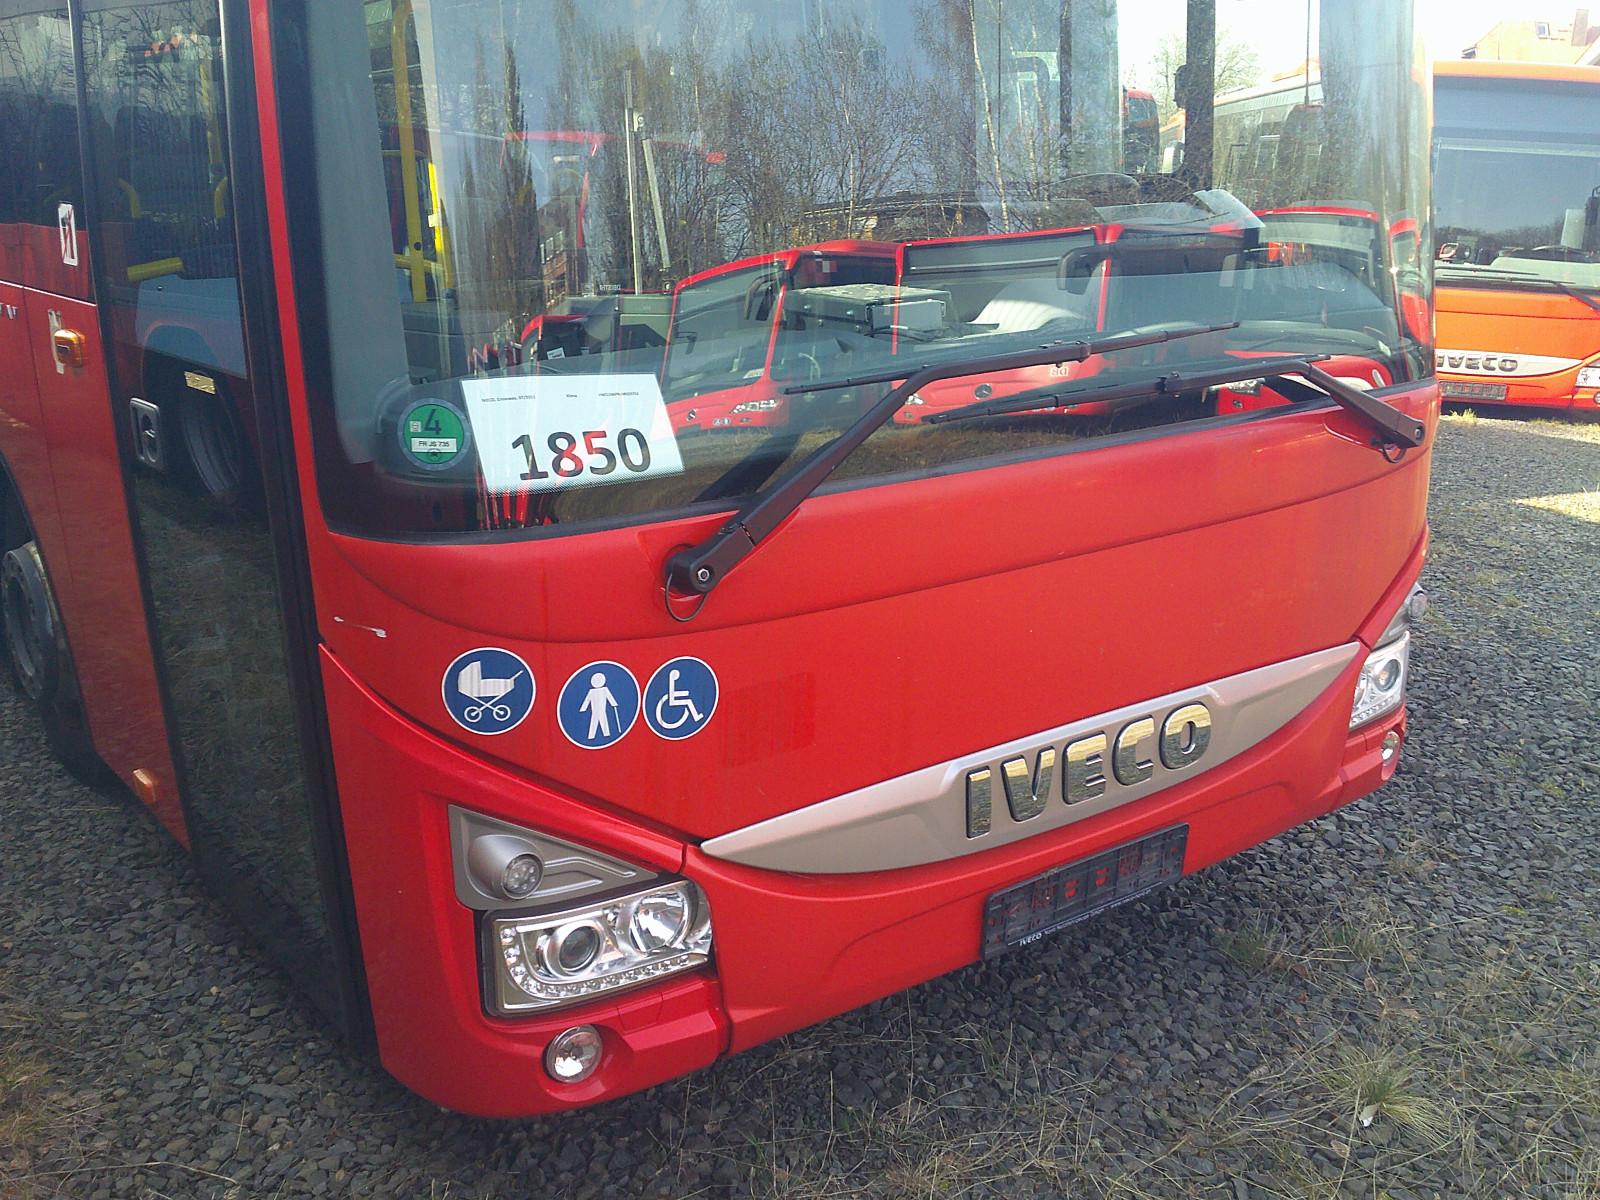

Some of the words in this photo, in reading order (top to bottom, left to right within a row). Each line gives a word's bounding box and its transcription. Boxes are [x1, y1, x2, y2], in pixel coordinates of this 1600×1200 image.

[1436, 354, 1518, 372] IVECO
[424, 408, 442, 435] 4
[511, 428, 651, 481] 1850
[965, 701, 1212, 839] IVECO
[1020, 932, 1042, 947] IVECO
